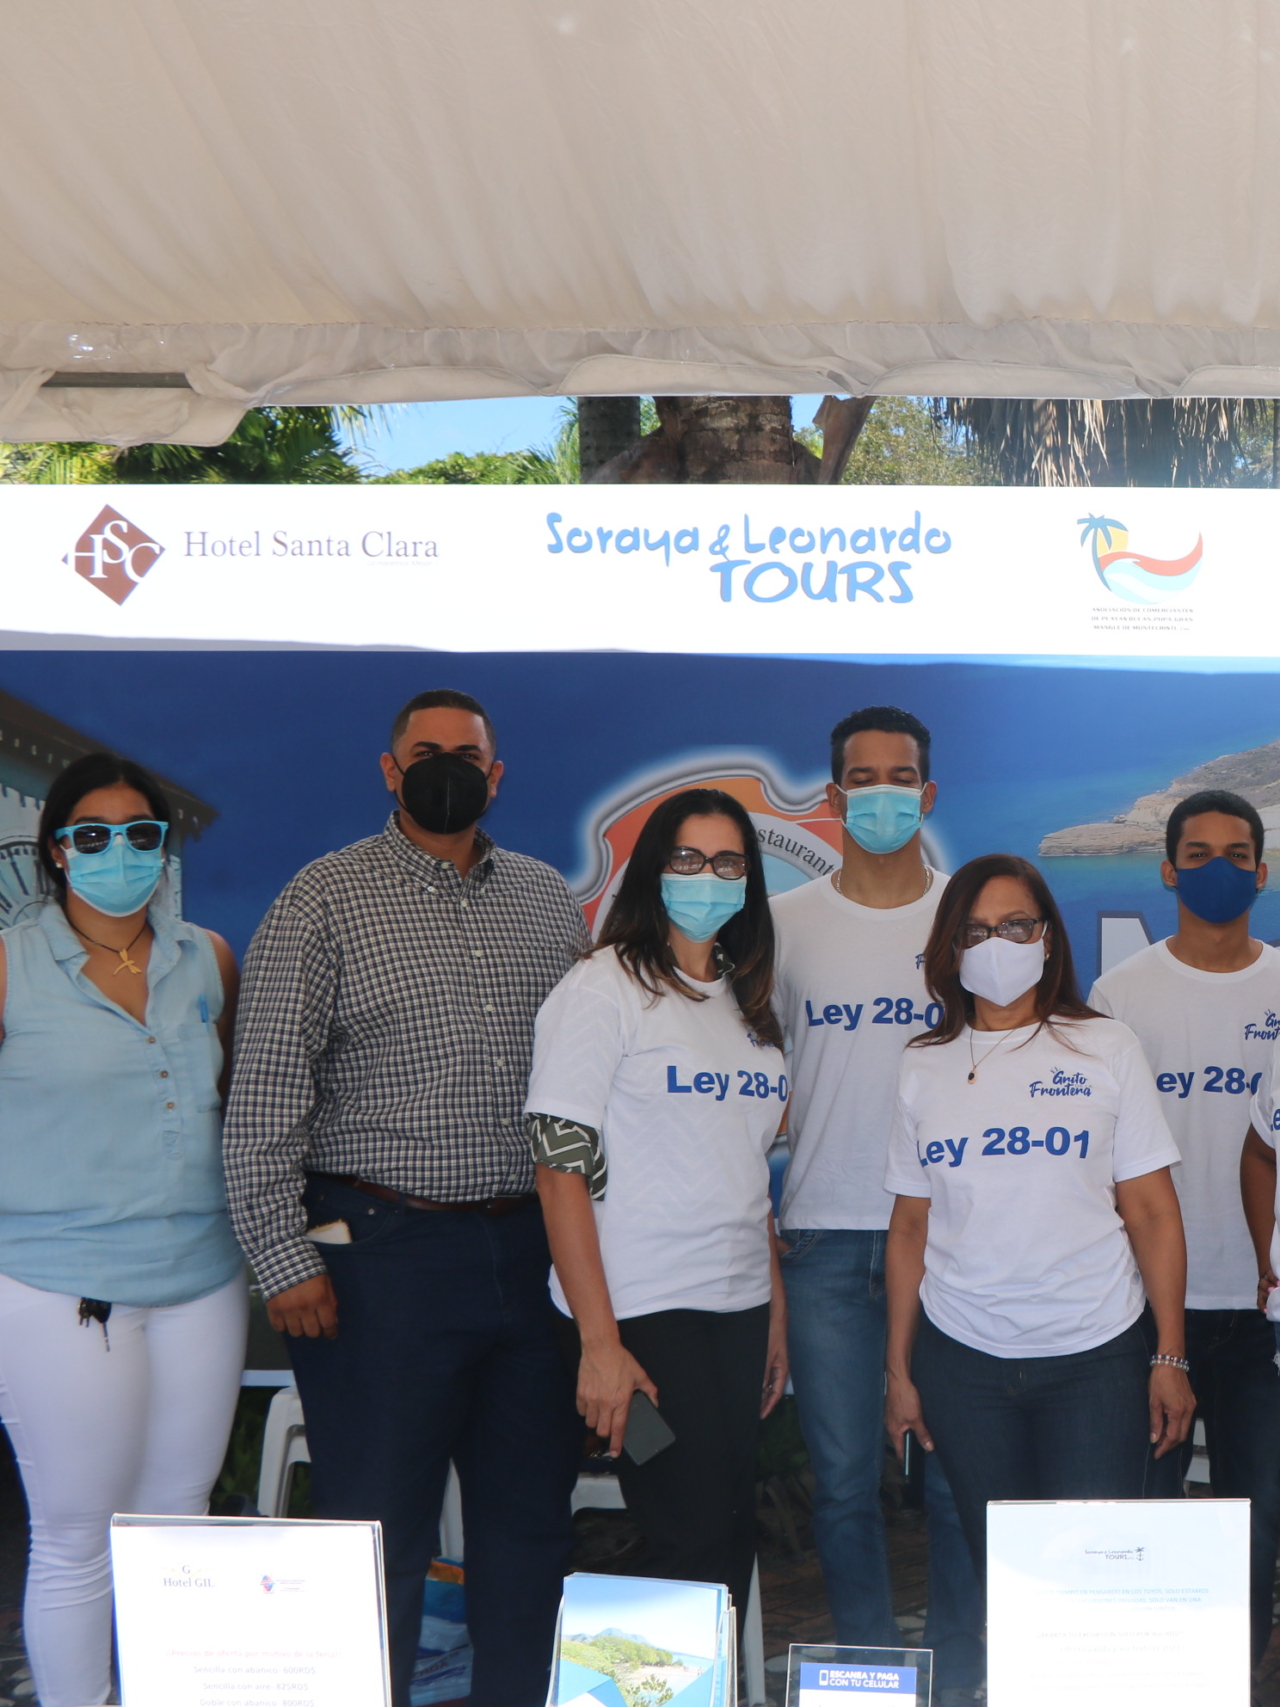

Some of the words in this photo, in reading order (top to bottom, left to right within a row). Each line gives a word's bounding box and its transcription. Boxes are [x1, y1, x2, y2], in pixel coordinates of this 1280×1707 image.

[184, 530, 262, 557] Hotel
[272, 530, 351, 557] Santa
[361, 530, 439, 558] Clara
[546, 512, 699, 566] Soraya
[708, 524, 730, 561] &
[744, 510, 952, 554] Leonardo
[709, 560, 914, 604] TOURS
[757, 828, 834, 876] staurant
[805, 1000, 863, 1031] Ley
[872, 997, 944, 1030] 28-0
[667, 1065, 730, 1101] Ley
[736, 1070, 788, 1102] 28-0
[1052, 1070, 1088, 1085] Grito
[1156, 1070, 1194, 1099] ey
[1202, 1066, 1262, 1095] 28-
[1029, 1081, 1092, 1098] Frontera
[982, 1126, 1090, 1159] 28-01
[182, 1565, 191, 1574] G
[164, 1578, 191, 1587] Hotel
[195, 1578, 215, 1588] GIL
[193, 1665, 226, 1674] Sencilla
[830, 1670, 868, 1679] ESCANEA
[870, 1672, 876, 1680] Y
[877, 1672, 899, 1680] PAGA
[202, 1682, 235, 1690] Sencilla
[863, 1680, 899, 1688] CELULAR
[200, 1698, 224, 1706] Doble
